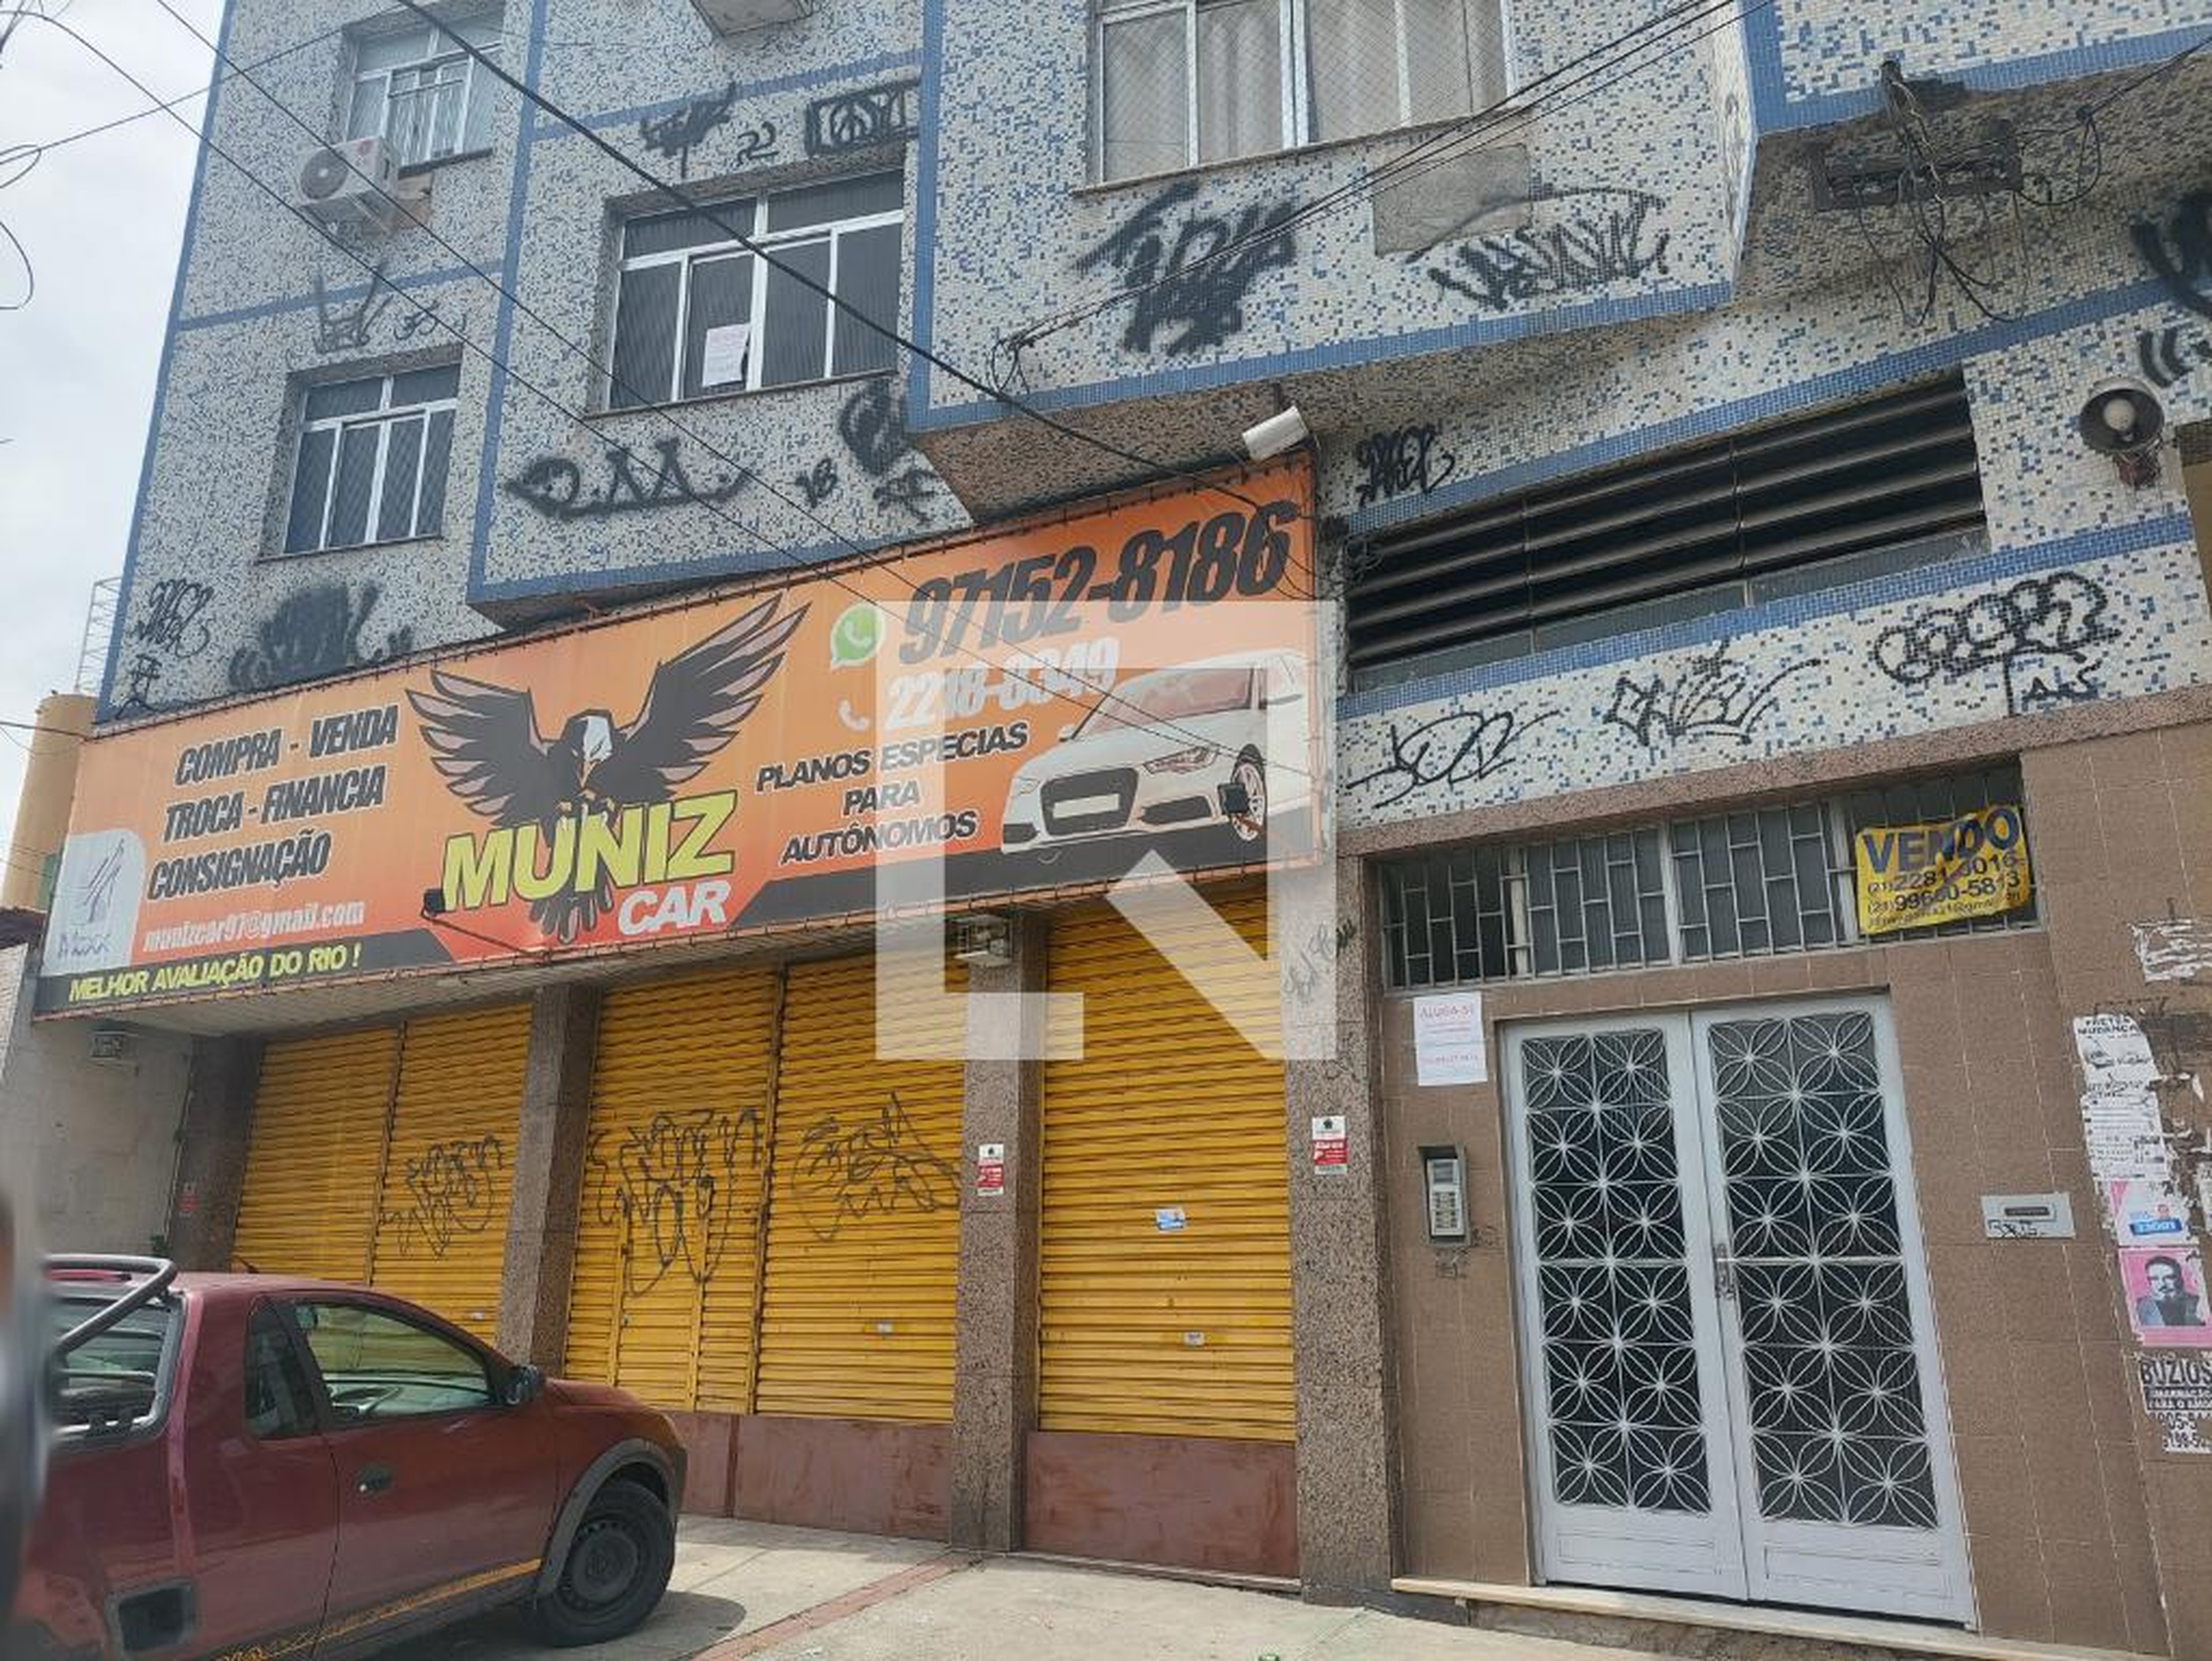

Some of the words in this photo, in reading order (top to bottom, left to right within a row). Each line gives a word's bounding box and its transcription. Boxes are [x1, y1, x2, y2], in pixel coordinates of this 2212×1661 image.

[899, 499, 1301, 664] 97152-8186
[175, 728, 282, 786] COMPRA
[309, 705, 398, 759] VENDA
[756, 749, 872, 792] PLANOS
[880, 721, 1028, 771] ESPECIAS
[163, 790, 245, 843] TROCA
[260, 765, 386, 824] FINANCIA
[842, 781, 922, 816] PARA
[147, 828, 332, 901] CONSIGNAÇÃO
[442, 789, 738, 912] MUNIZ
[779, 811, 978, 865] AUTÔNOMOS
[1863, 807, 2020, 874] VENDO
[618, 880, 732, 937] CAR
[69, 970, 150, 1002] MELHOR
[151, 952, 264, 992] AVALIAÇÃO
[269, 951, 303, 978] DO
[306, 945, 347, 972] RIO
